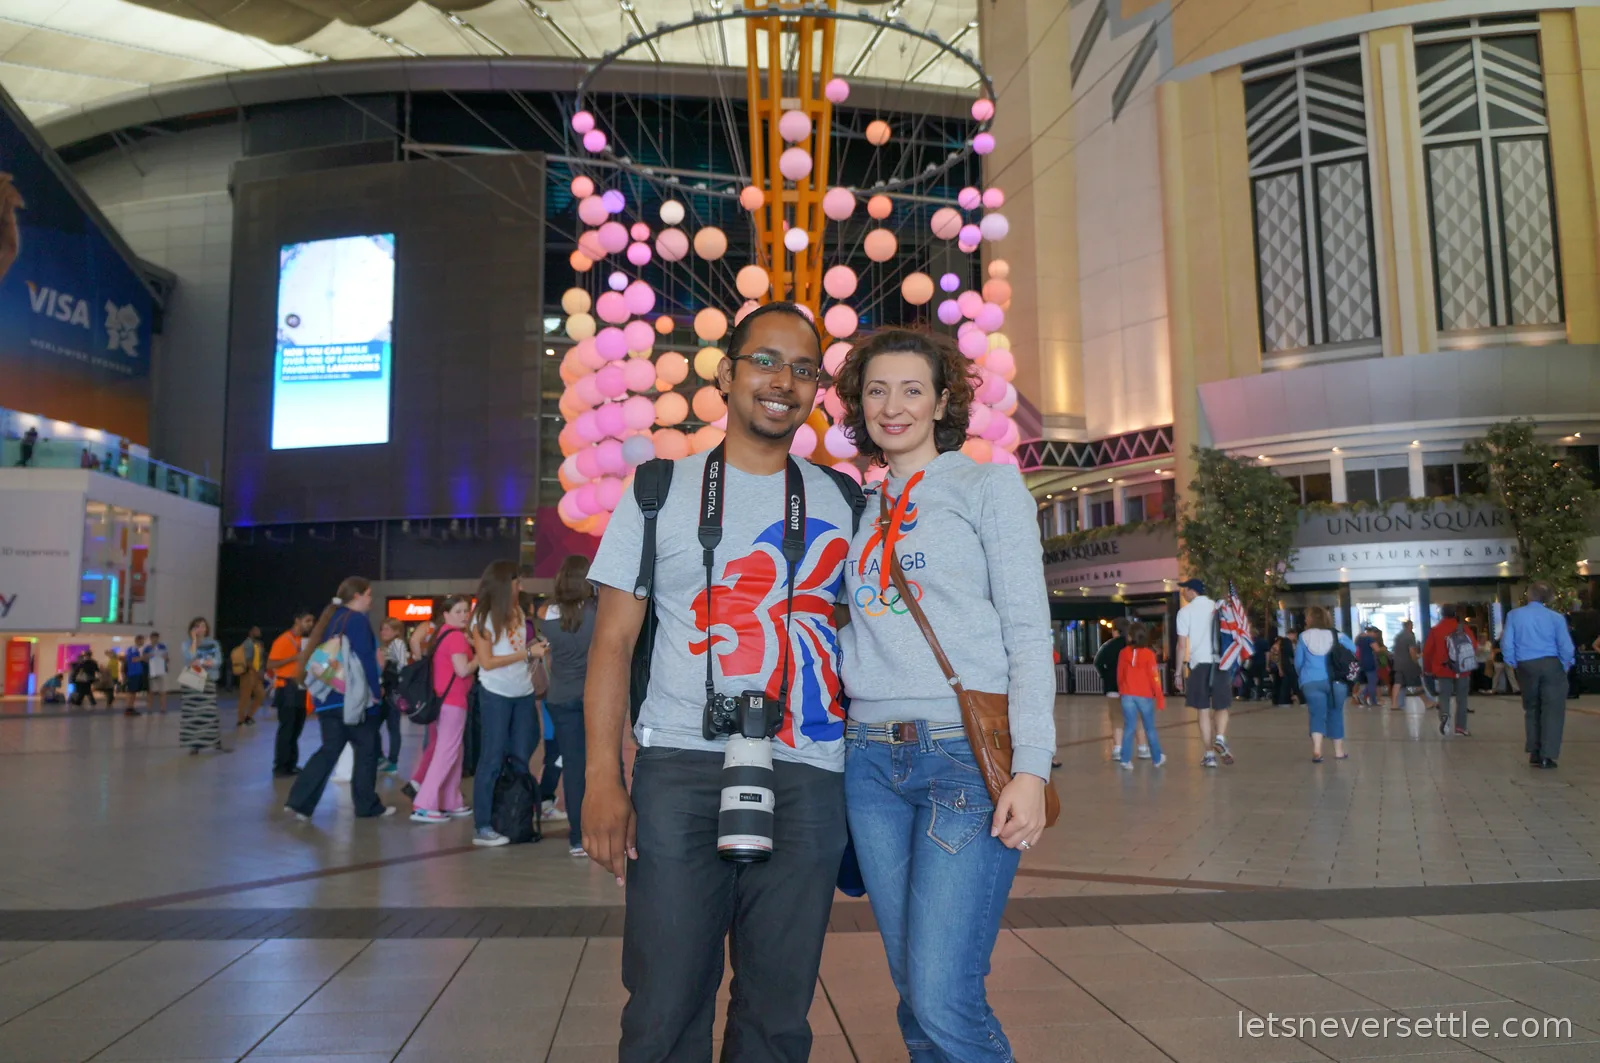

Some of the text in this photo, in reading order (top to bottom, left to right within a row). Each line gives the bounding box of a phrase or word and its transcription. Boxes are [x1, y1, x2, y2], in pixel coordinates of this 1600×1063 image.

[25, 280, 90, 330] VISA
[707, 461, 718, 519] EOS DIGITAL
[790, 494, 801, 530] Canon
[1327, 510, 1508, 535] UNION SQUAR
[900, 551, 926, 571] GB
[1070, 540, 1120, 561] SQUARE
[1328, 545, 1520, 563] RESTAURANT & BAR
